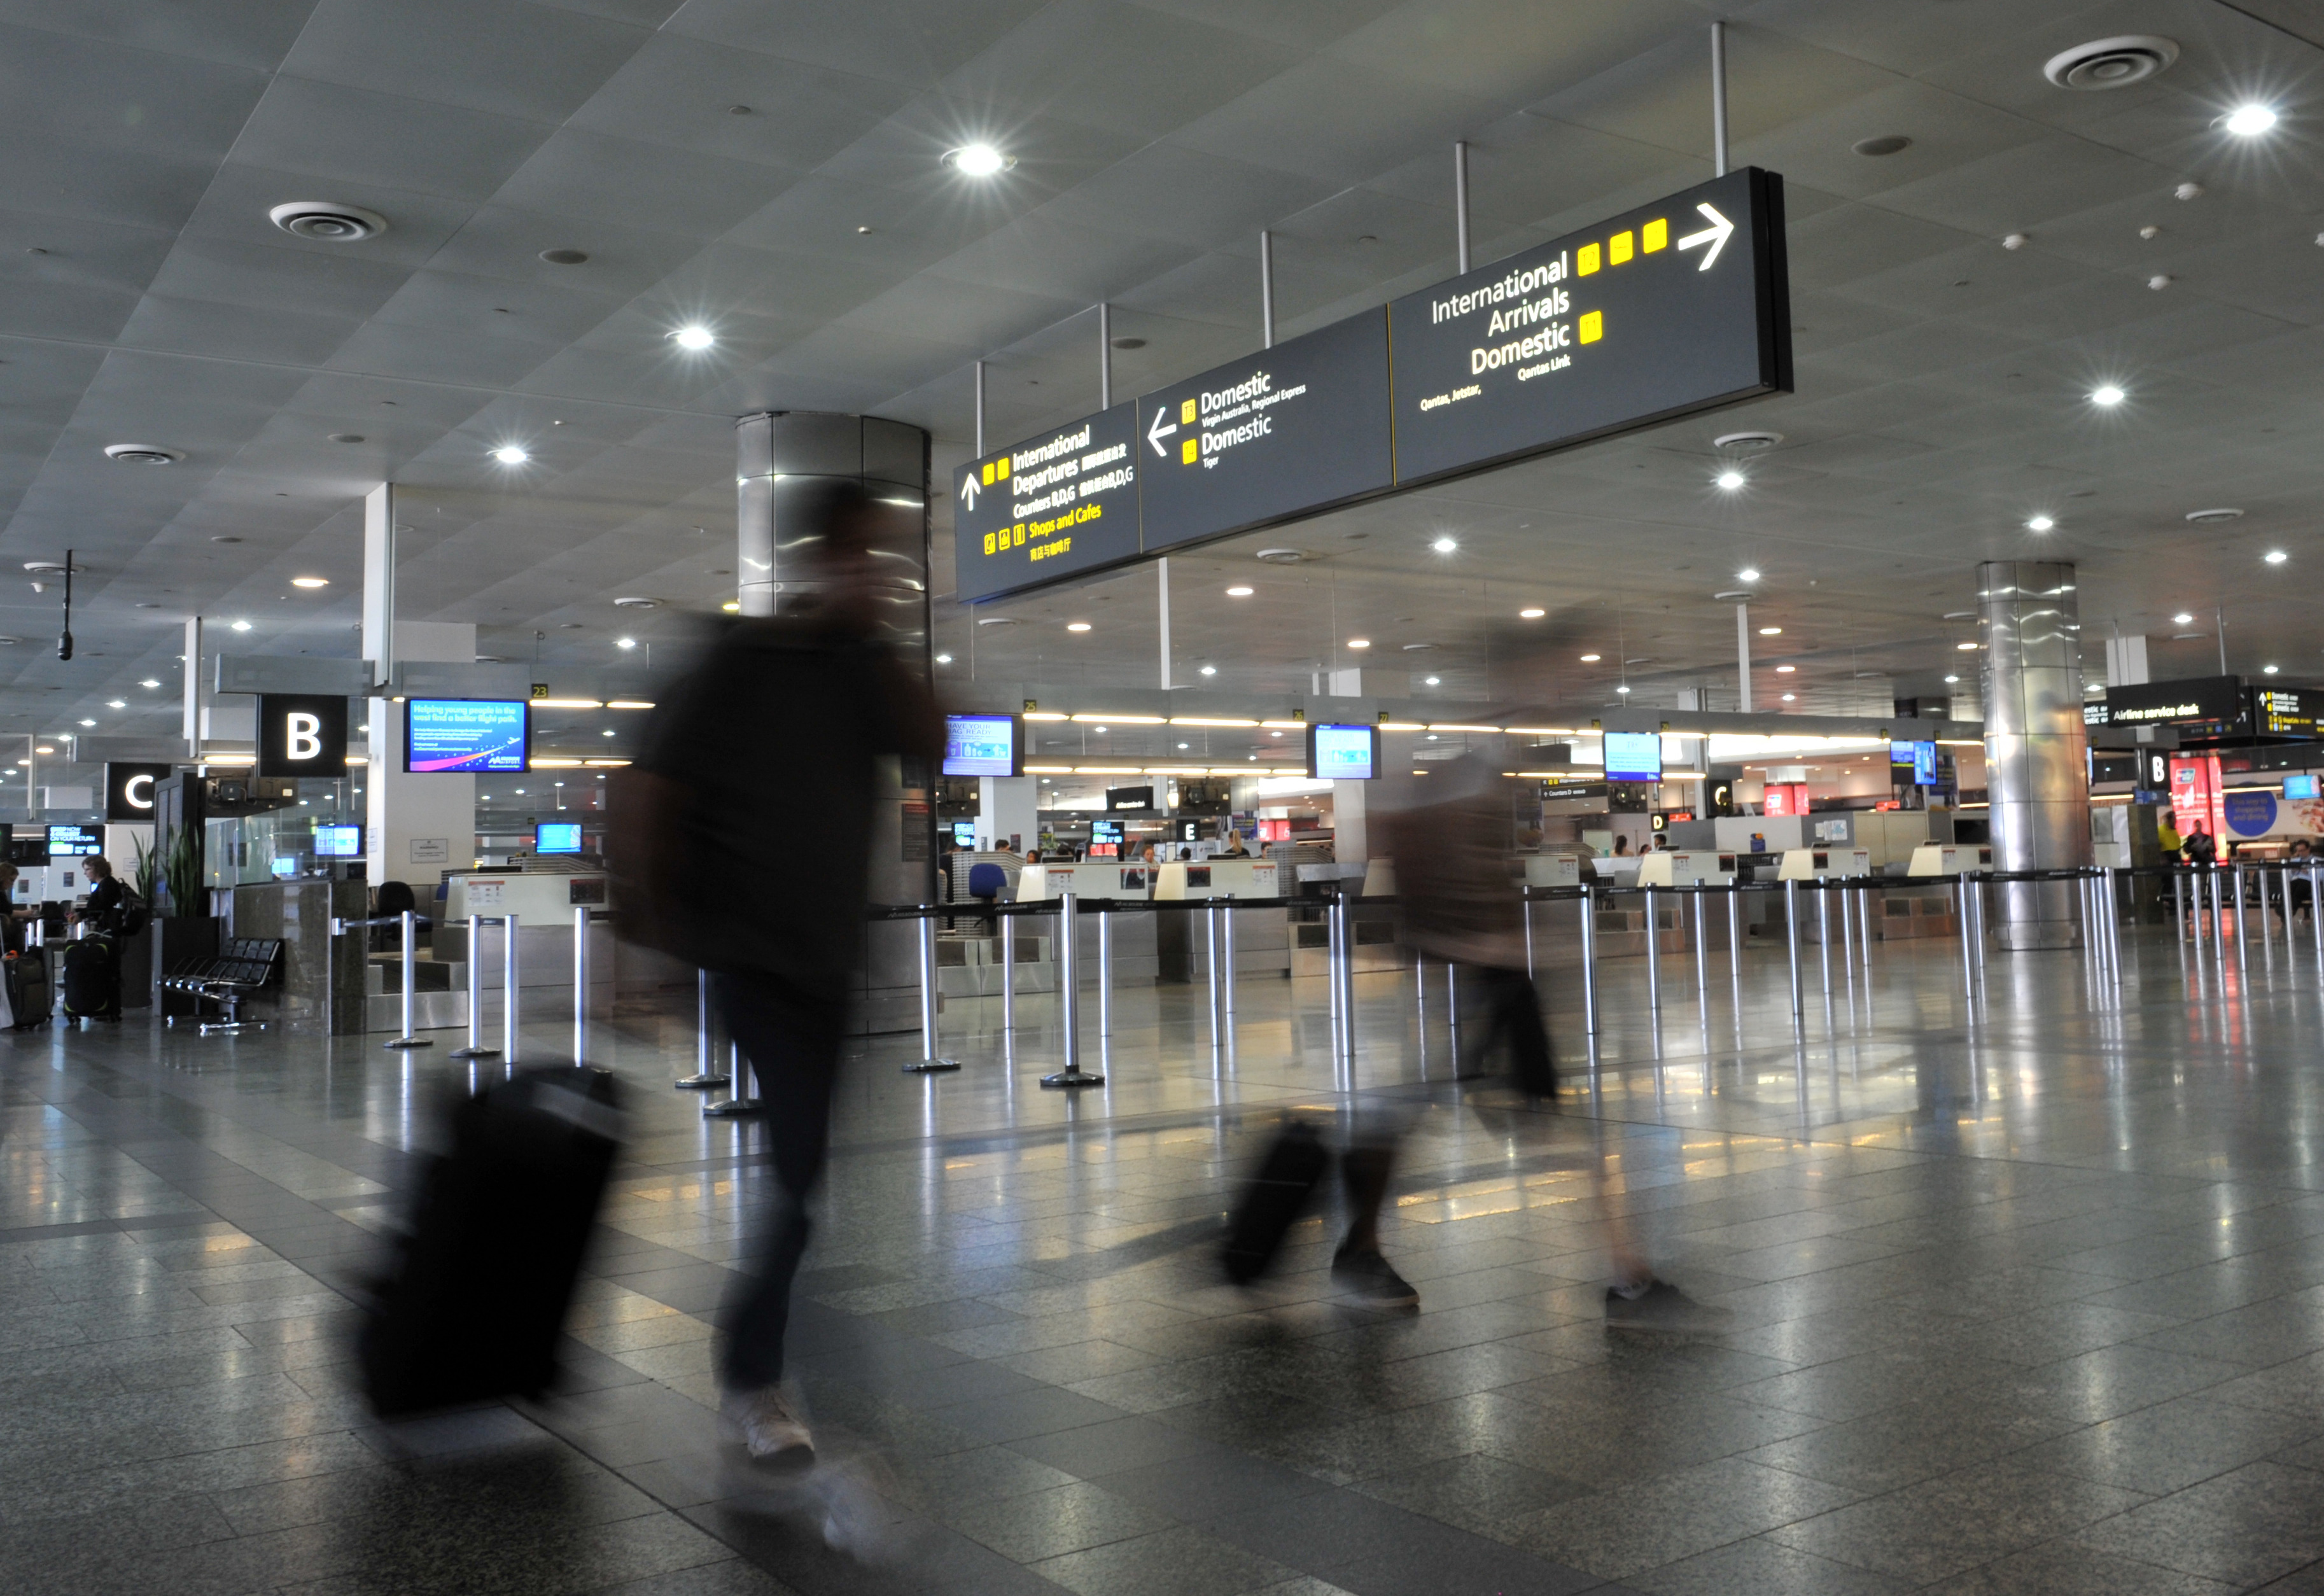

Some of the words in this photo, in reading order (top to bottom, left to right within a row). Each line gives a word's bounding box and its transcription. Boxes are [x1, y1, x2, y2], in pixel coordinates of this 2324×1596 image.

[1432, 250, 1567, 324] International
[1488, 287, 1570, 337] Arrivals
[1471, 321, 1571, 375] Domestic
[1518, 362, 1550, 381] Qantas
[1550, 354, 1571, 371] Link
[1201, 371, 1271, 414] Domestic
[1201, 414, 1221, 428] Virgin
[1221, 403, 1251, 421] Australia,
[1251, 391, 1280, 410] Regional
[1280, 384, 1306, 400] Express
[1420, 393, 1452, 411] Qantas,
[1451, 384, 1482, 402] Jetstar,
[1202, 413, 1272, 455] Domestic
[1013, 424, 1090, 472] International
[1203, 456, 1219, 469] Tiger
[1013, 459, 1079, 496] Departures
[1013, 496, 1051, 519] Counters
[1051, 485, 1075, 508] B,D,G
[1029, 520, 1056, 538] Shops
[1056, 510, 1074, 530] and
[1075, 503, 1102, 523] Cafes
[533, 687, 547, 697] 23
[414, 704, 444, 715] Helping
[445, 706, 467, 716] young
[468, 706, 494, 715] people
[495, 706, 502, 714] in
[503, 706, 516, 715] the
[431, 712, 447, 721] find
[454, 713, 477, 722] better
[477, 713, 497, 724] flight
[498, 714, 517, 724] path.
[1026, 702, 1035, 711] 25
[2083, 705, 2099, 714] estic
[2113, 709, 2143, 720] Airline
[2145, 706, 2176, 718] service
[2176, 703, 2200, 716] desk
[2084, 717, 2099, 725] estic
[287, 712, 321, 760] B
[2152, 756, 2165, 782] B
[125, 774, 153, 809] C
[1653, 816, 1663, 829] D
[2233, 813, 2246, 822] and
[1186, 823, 1195, 840] E
